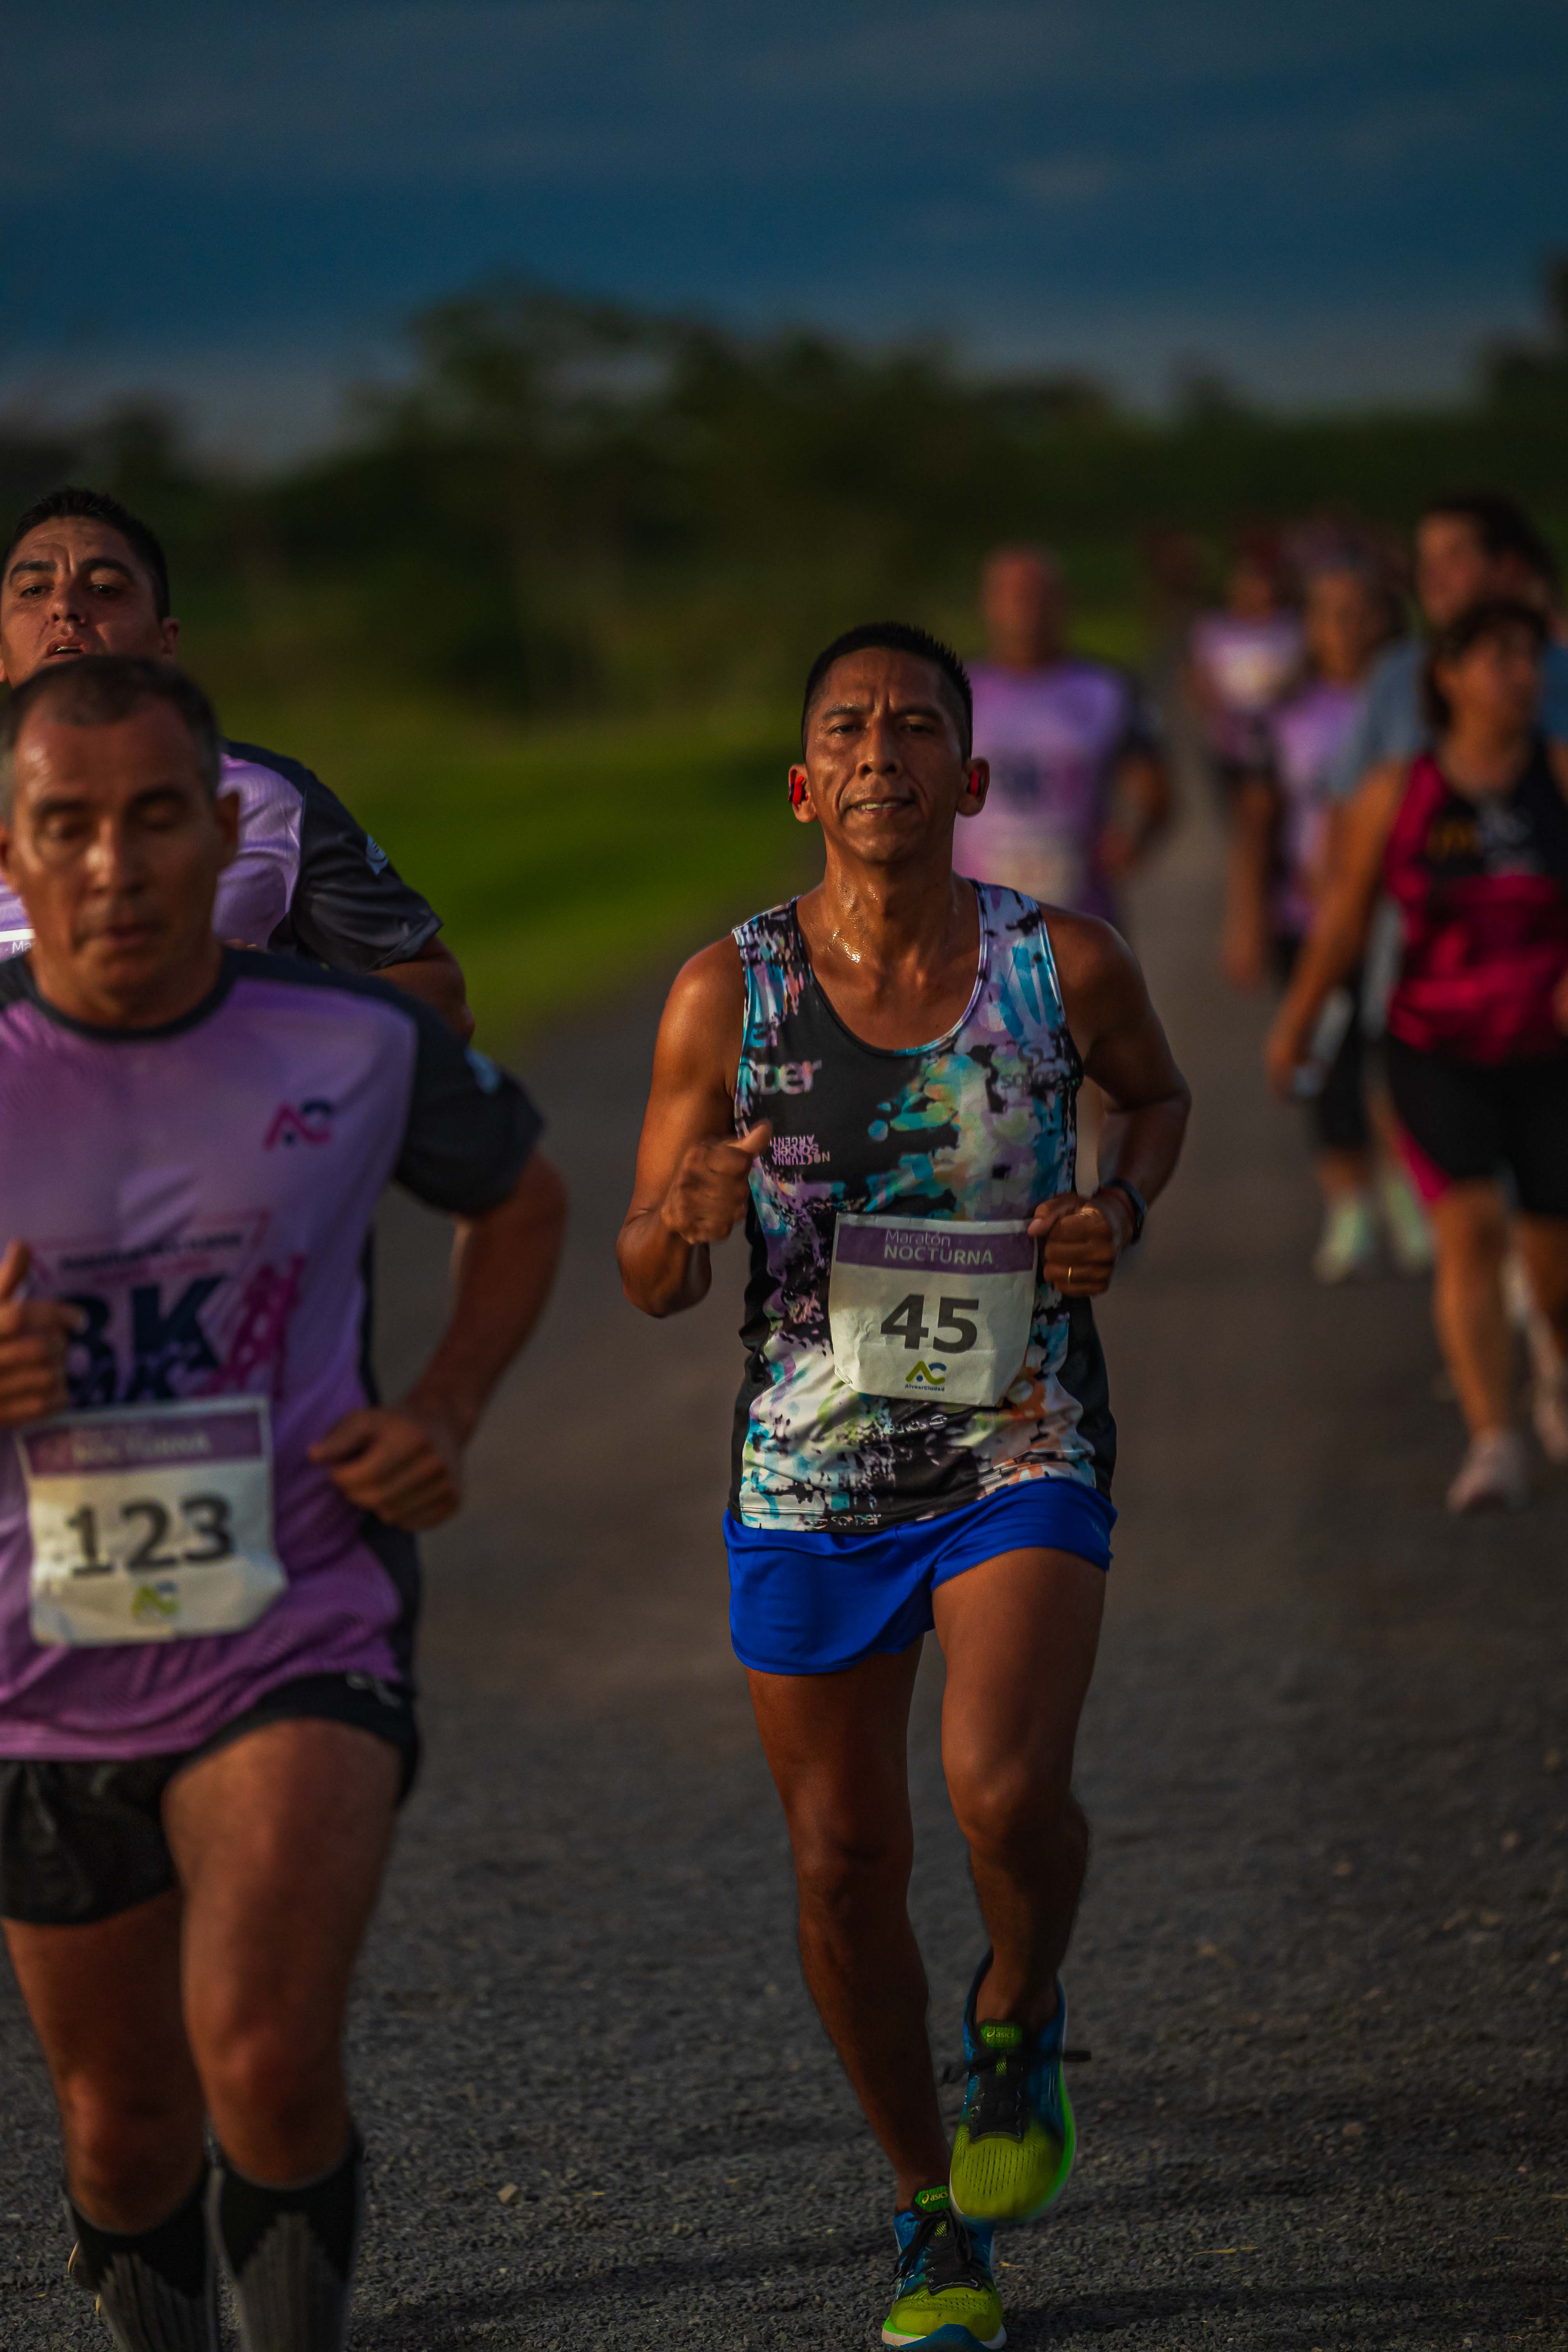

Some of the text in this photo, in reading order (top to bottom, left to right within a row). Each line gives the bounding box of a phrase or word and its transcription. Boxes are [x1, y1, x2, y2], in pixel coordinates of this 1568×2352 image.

[883, 1245, 993, 1265] NOCTURNA
[885, 1229, 951, 1247] Maratón
[881, 1294, 980, 1353] 45
[67, 1494, 234, 1578] 123
